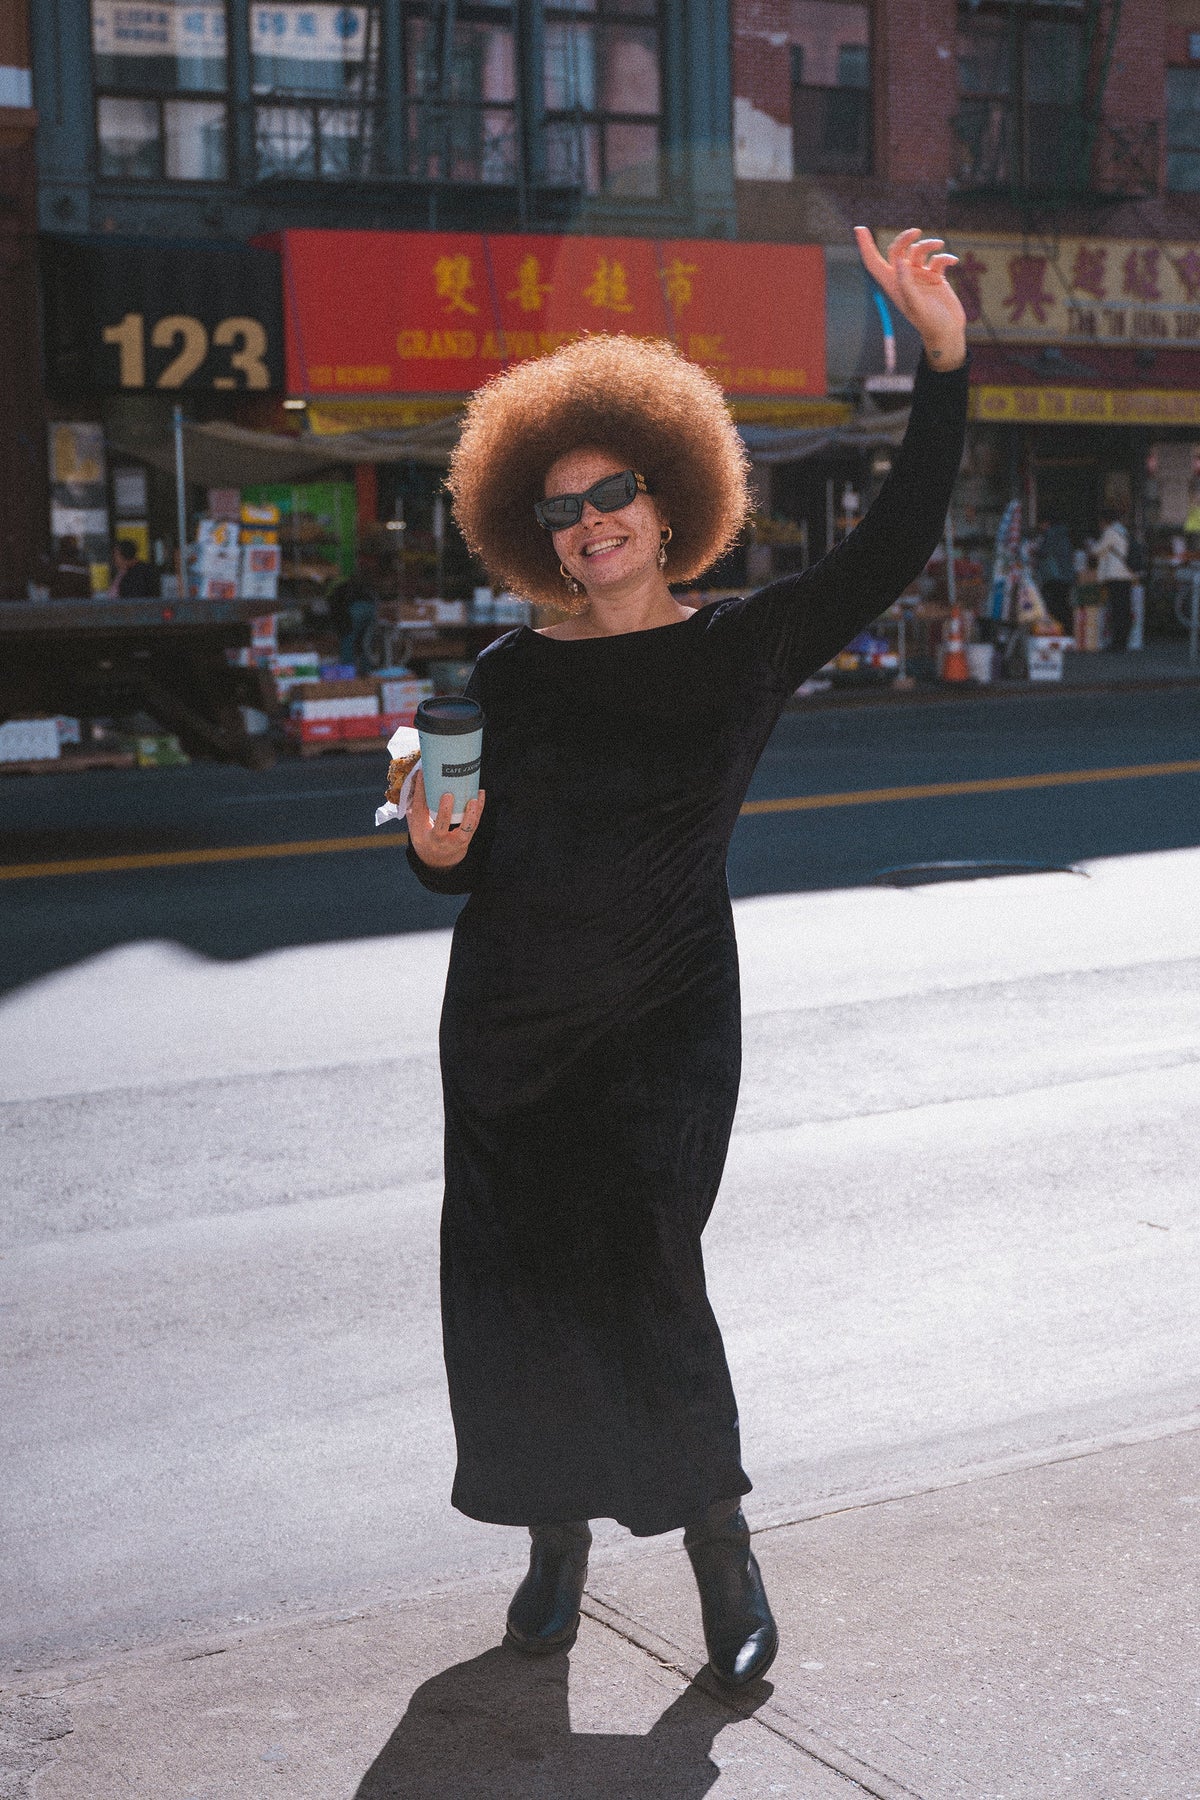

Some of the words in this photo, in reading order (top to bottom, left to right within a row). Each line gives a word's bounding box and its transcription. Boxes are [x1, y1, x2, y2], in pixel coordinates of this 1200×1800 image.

[434, 253, 698, 316] 雙喜超市
[102, 313, 271, 390] 123
[397, 330, 477, 360] GRAND
